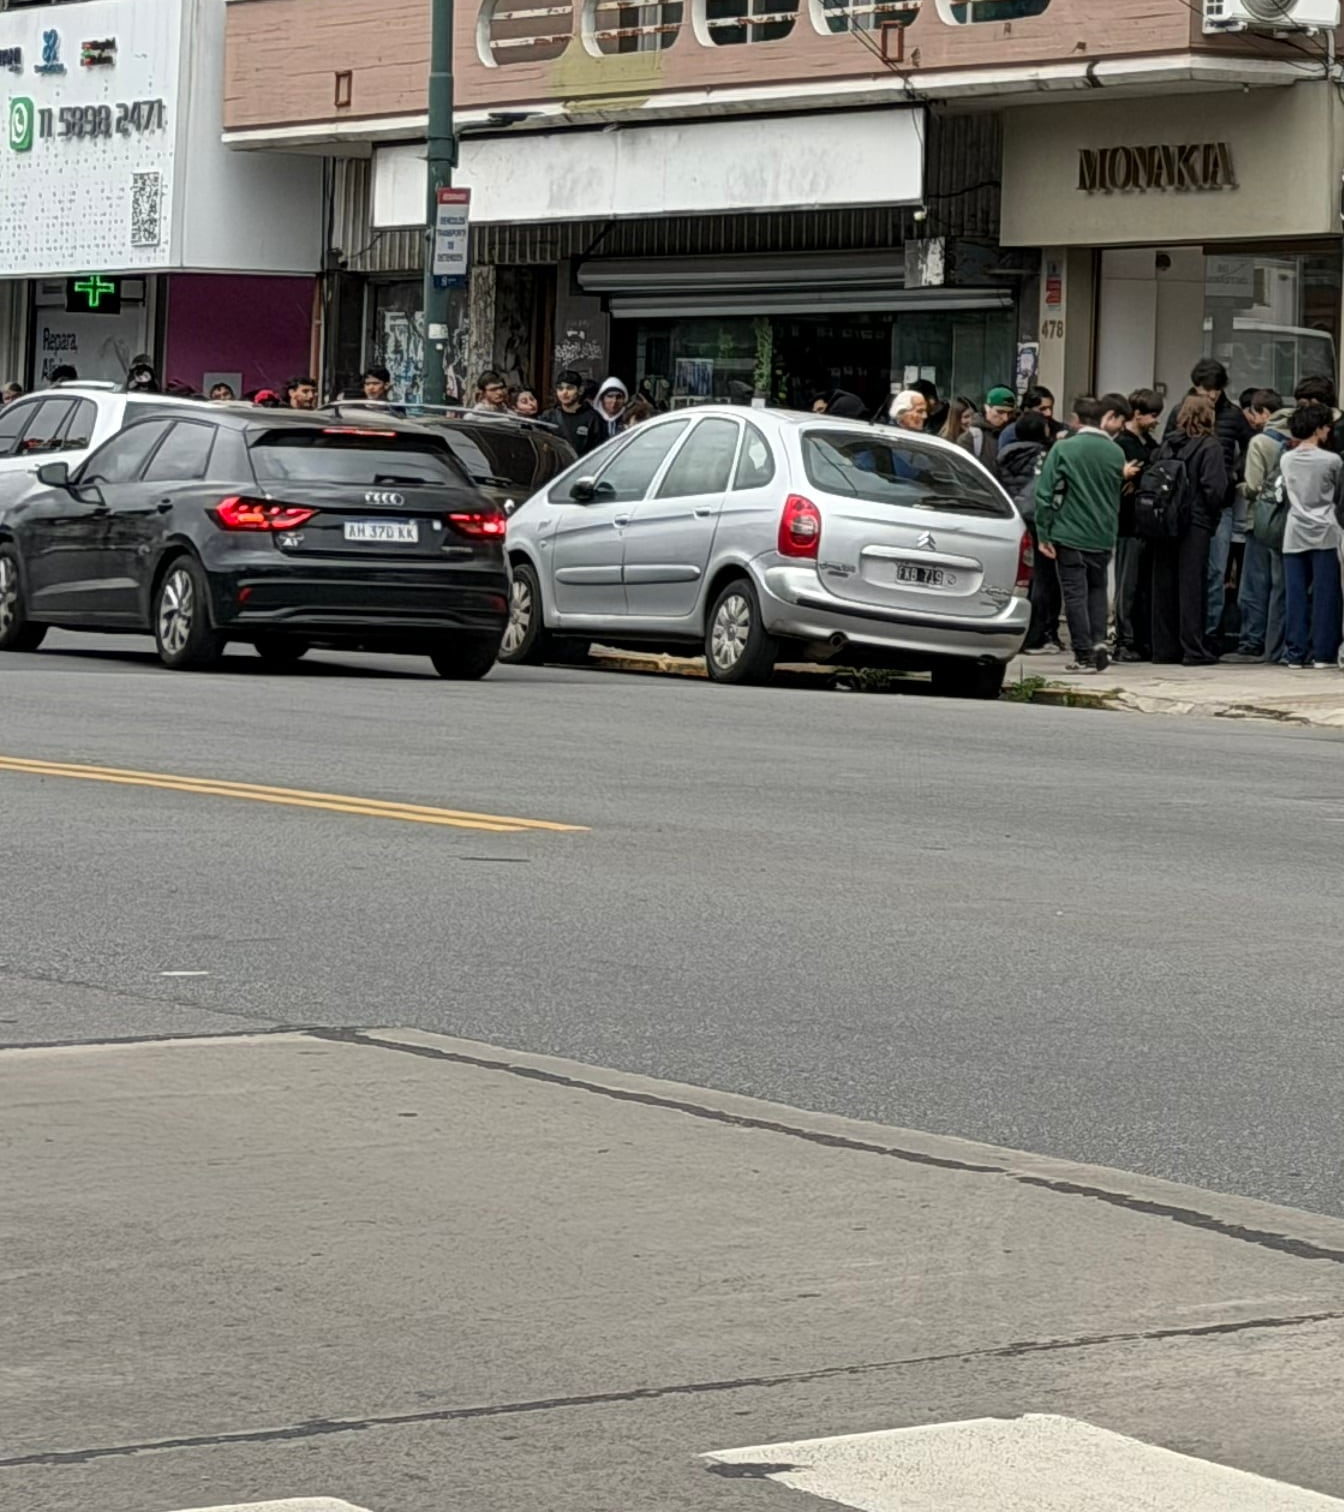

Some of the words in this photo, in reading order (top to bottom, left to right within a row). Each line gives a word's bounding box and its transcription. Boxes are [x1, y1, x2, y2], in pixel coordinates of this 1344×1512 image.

[38, 108, 53, 138] 11
[1041, 319, 1064, 338] 478
[349, 525, 365, 538] AH
